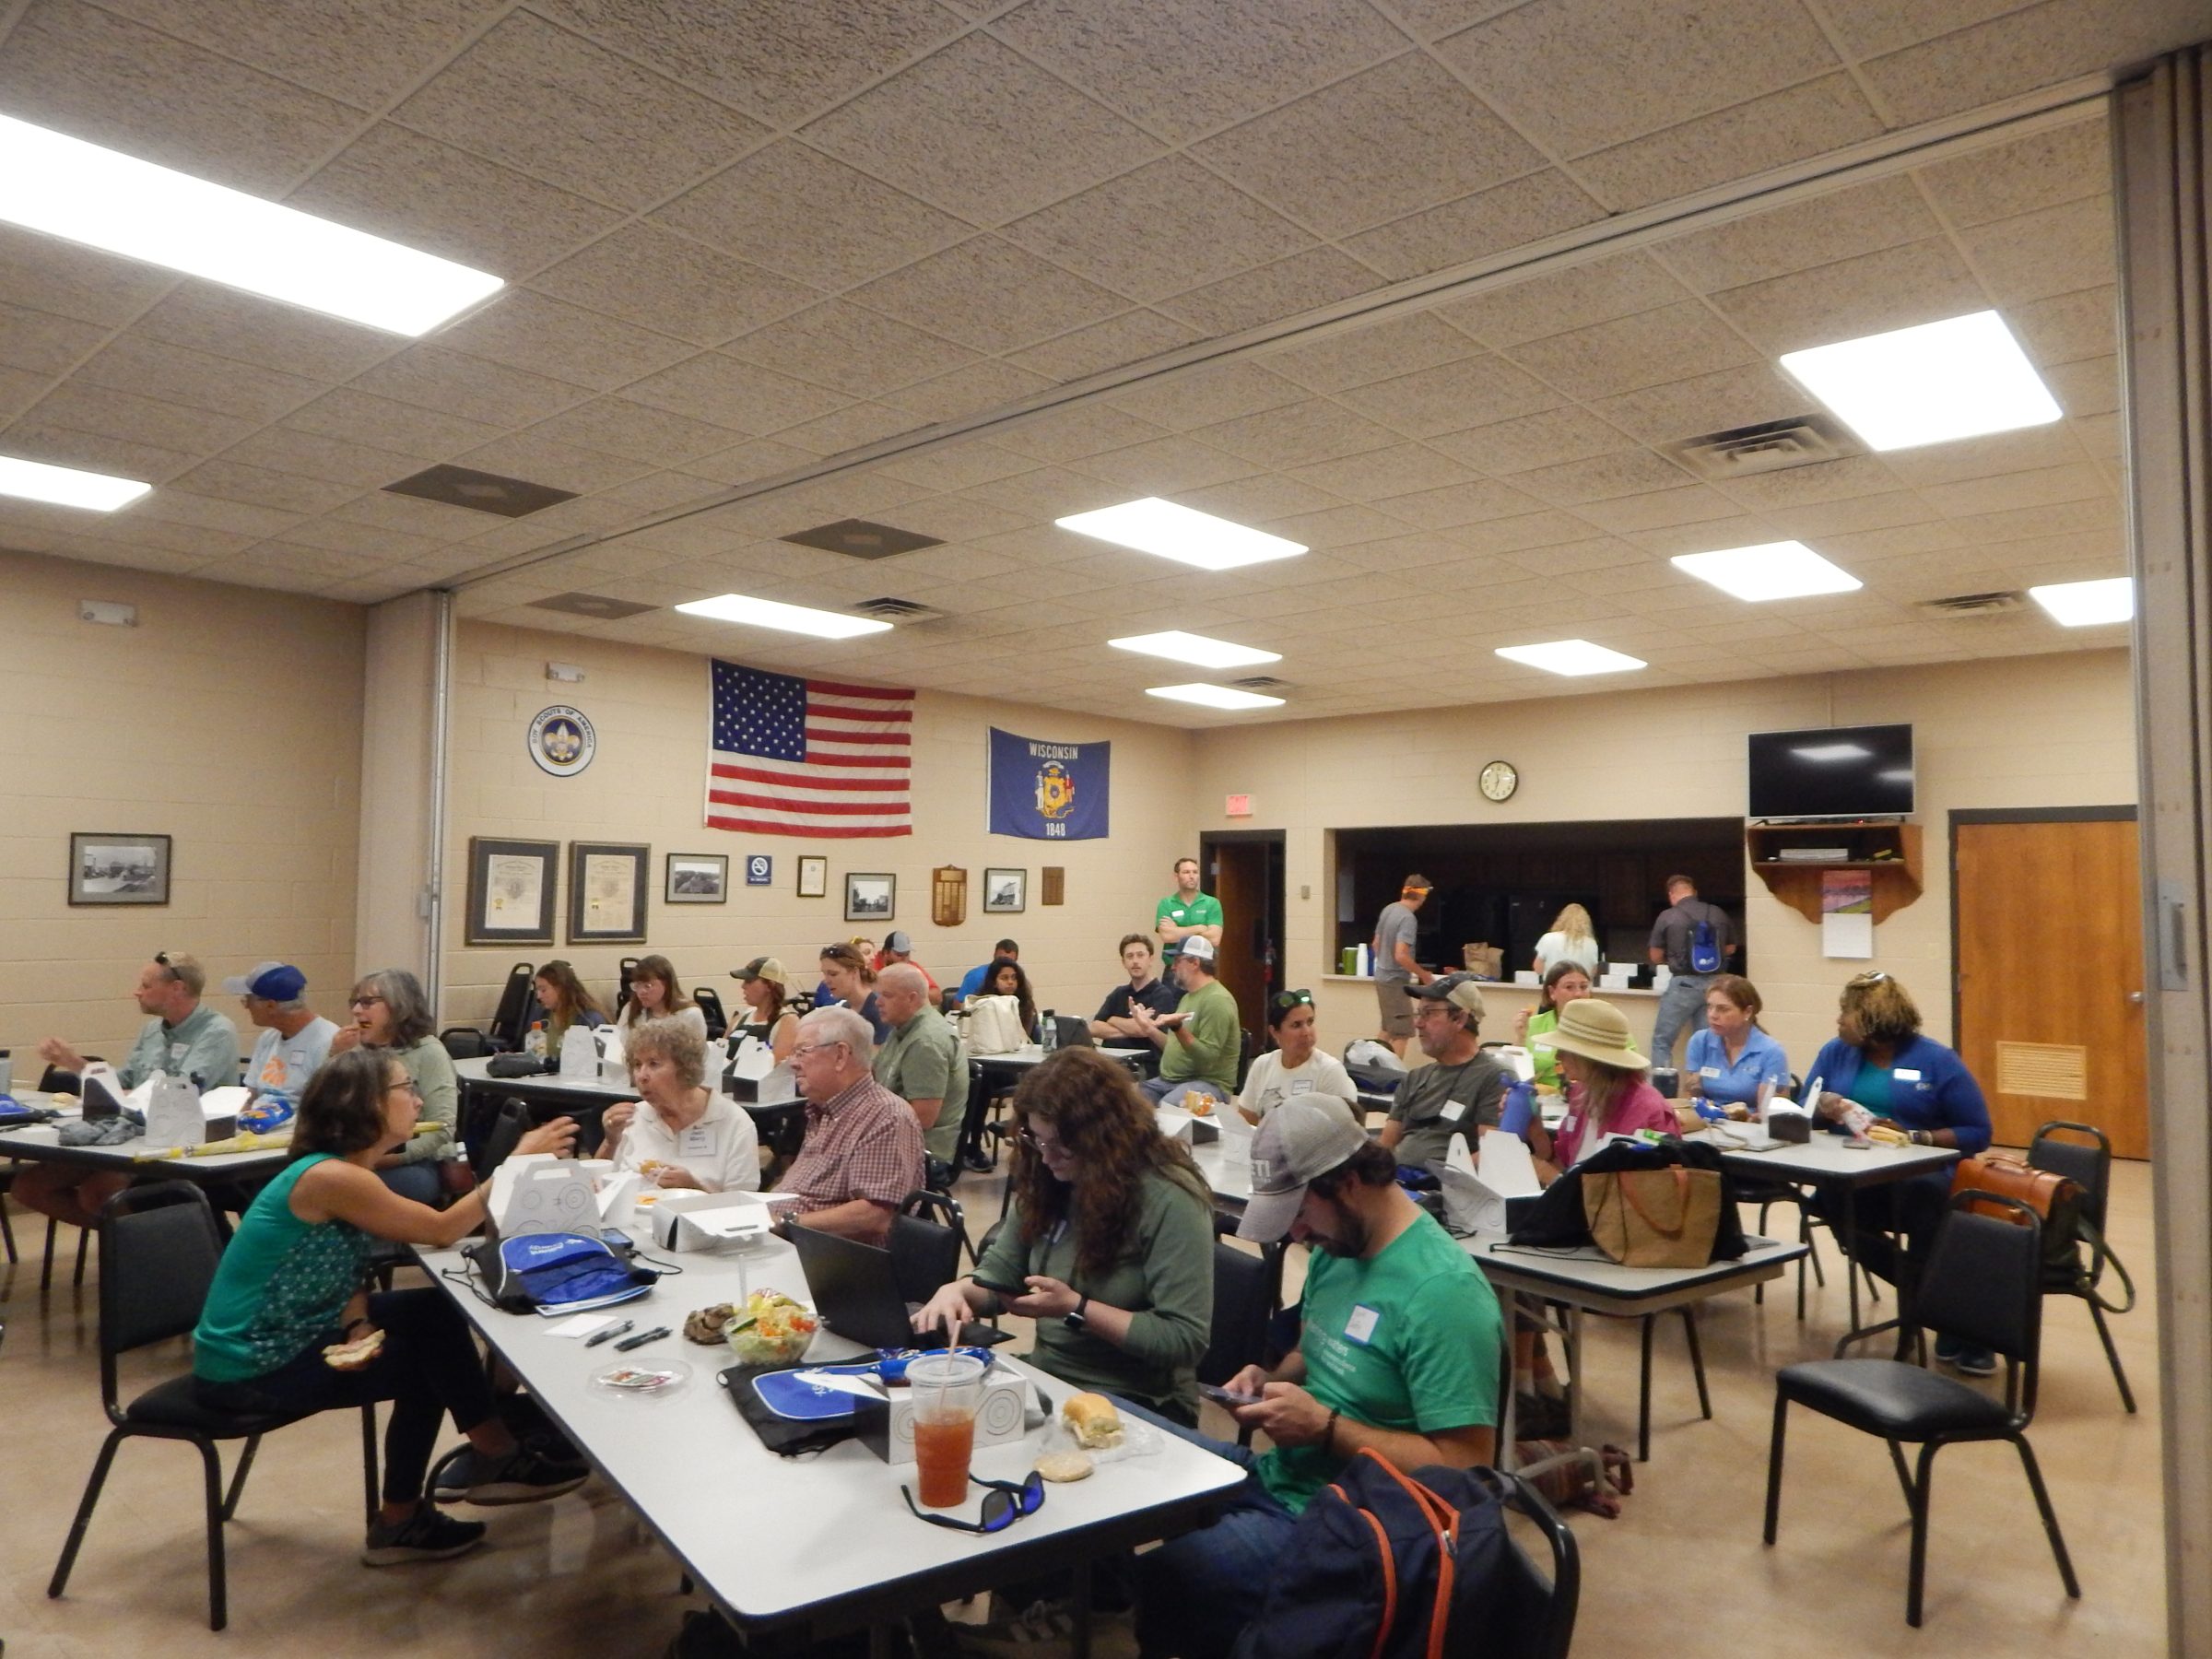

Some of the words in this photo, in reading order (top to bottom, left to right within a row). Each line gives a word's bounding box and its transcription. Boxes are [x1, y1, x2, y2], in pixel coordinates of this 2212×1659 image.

[536, 708, 561, 725] SCOUTS
[578, 716, 593, 747] AMERICA
[1029, 742, 1078, 759] WISCONSIN
[1045, 822, 1066, 836] 1848
